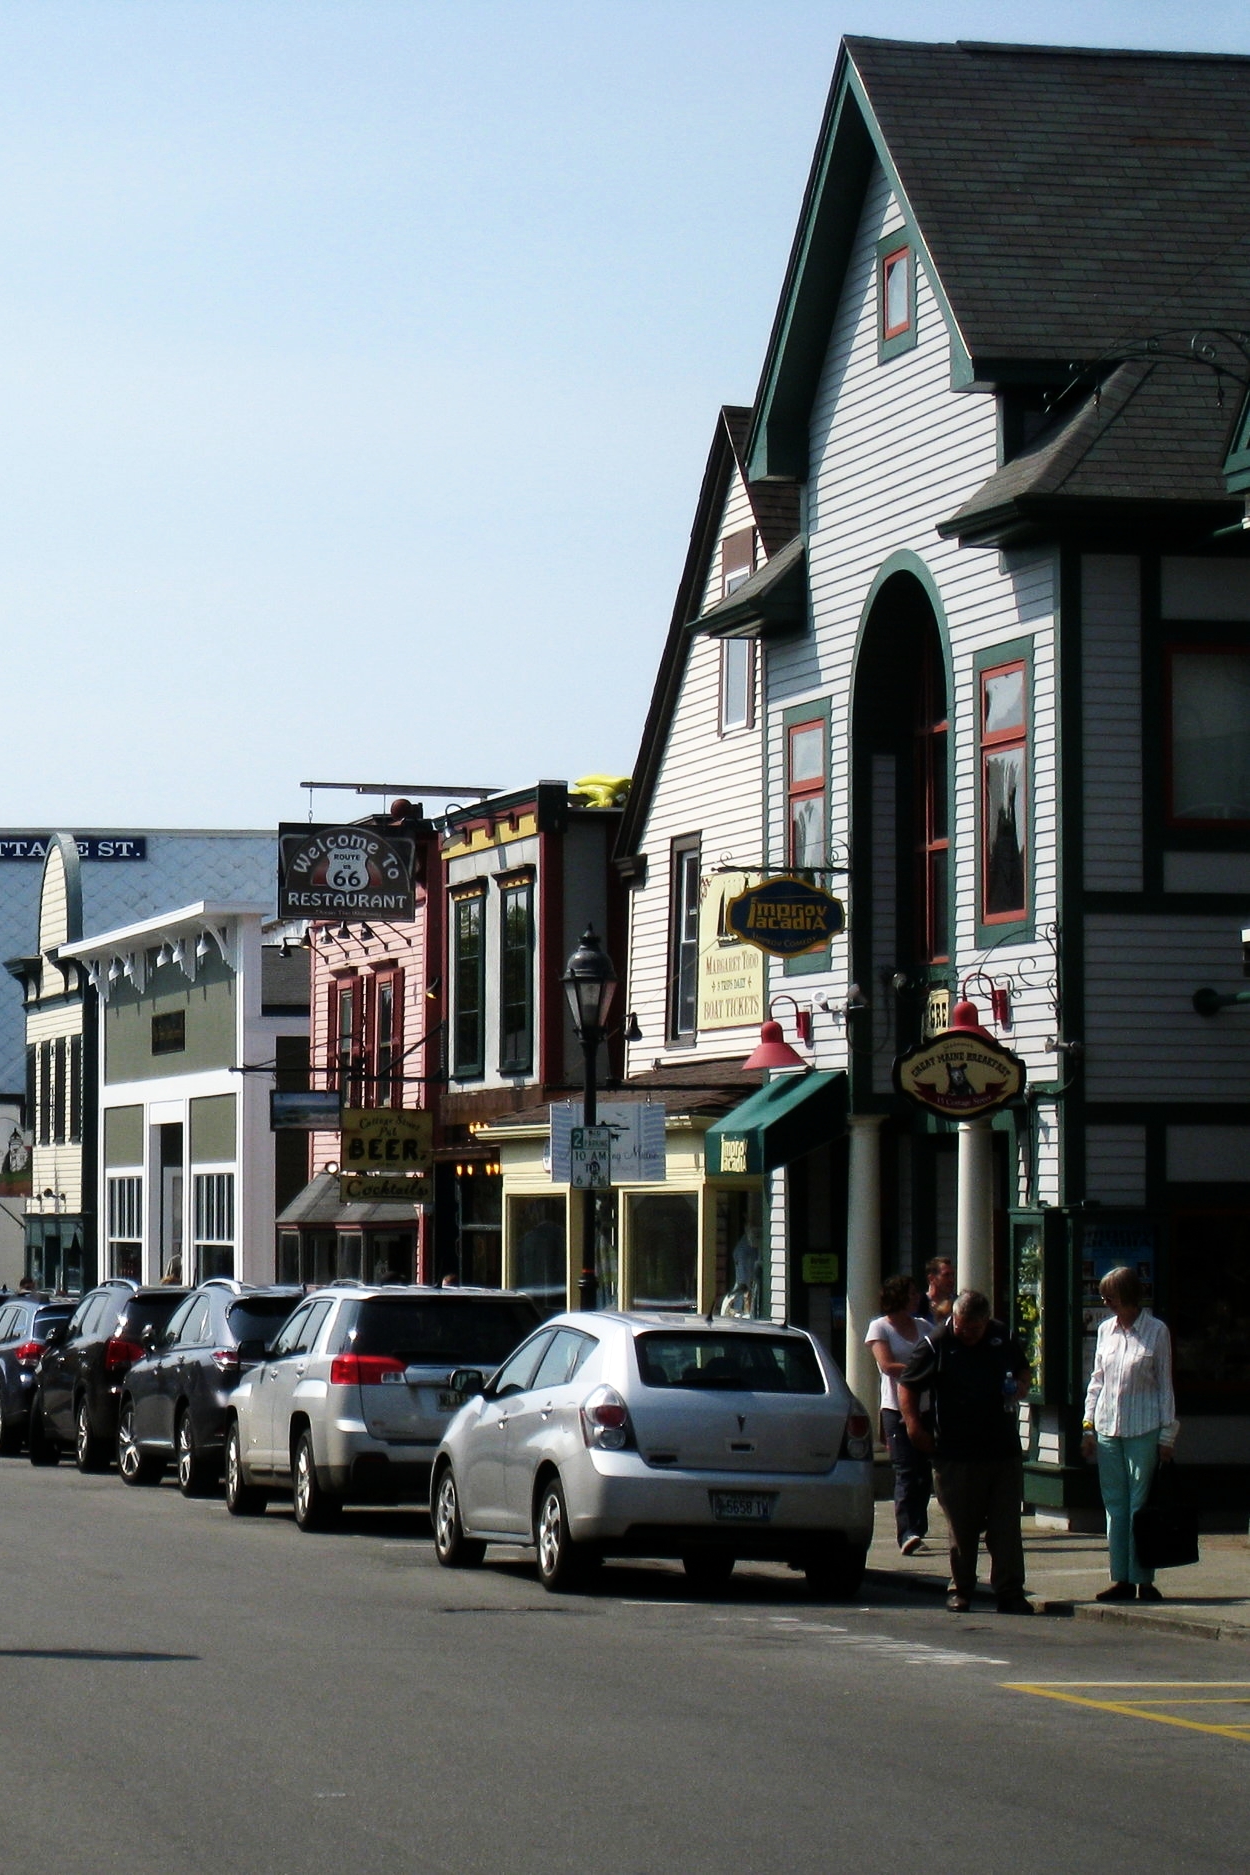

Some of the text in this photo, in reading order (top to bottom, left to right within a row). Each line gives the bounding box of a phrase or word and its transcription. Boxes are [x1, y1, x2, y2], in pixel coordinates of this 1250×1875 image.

[97, 841, 141, 857] ST.
[293, 834, 400, 879] Welcome To
[333, 853, 361, 861] ROUTE
[333, 870, 361, 887] 66
[287, 892, 407, 909] RESTAURANT
[704, 994, 760, 1020] BOAT TICKETS
[911, 1051, 1011, 1078] GREAT MAINE BREAKFAST
[575, 1151, 587, 1161] 10
[591, 1151, 607, 1161] AM
